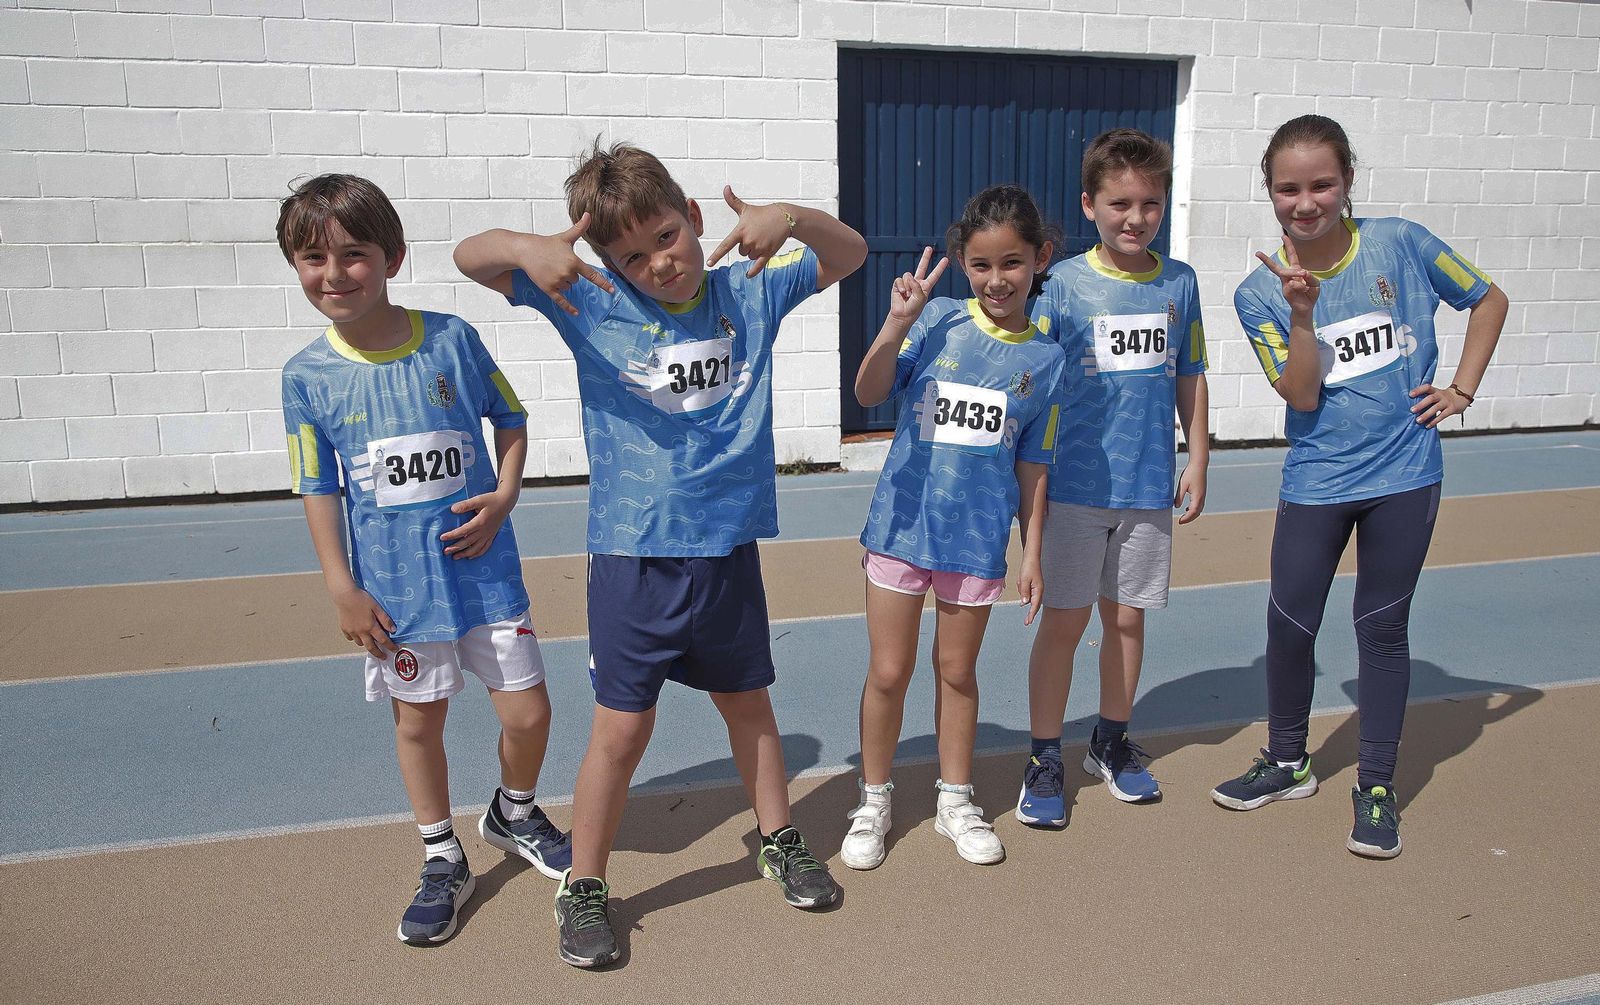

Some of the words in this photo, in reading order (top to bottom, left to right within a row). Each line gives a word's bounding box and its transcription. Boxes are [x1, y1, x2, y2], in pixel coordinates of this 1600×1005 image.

[1110, 327, 1166, 356] 3476
[1334, 322, 1394, 363] 3477
[667, 354, 731, 394] 3421
[933, 397, 1003, 433] 3433
[385, 446, 462, 487] 3420
